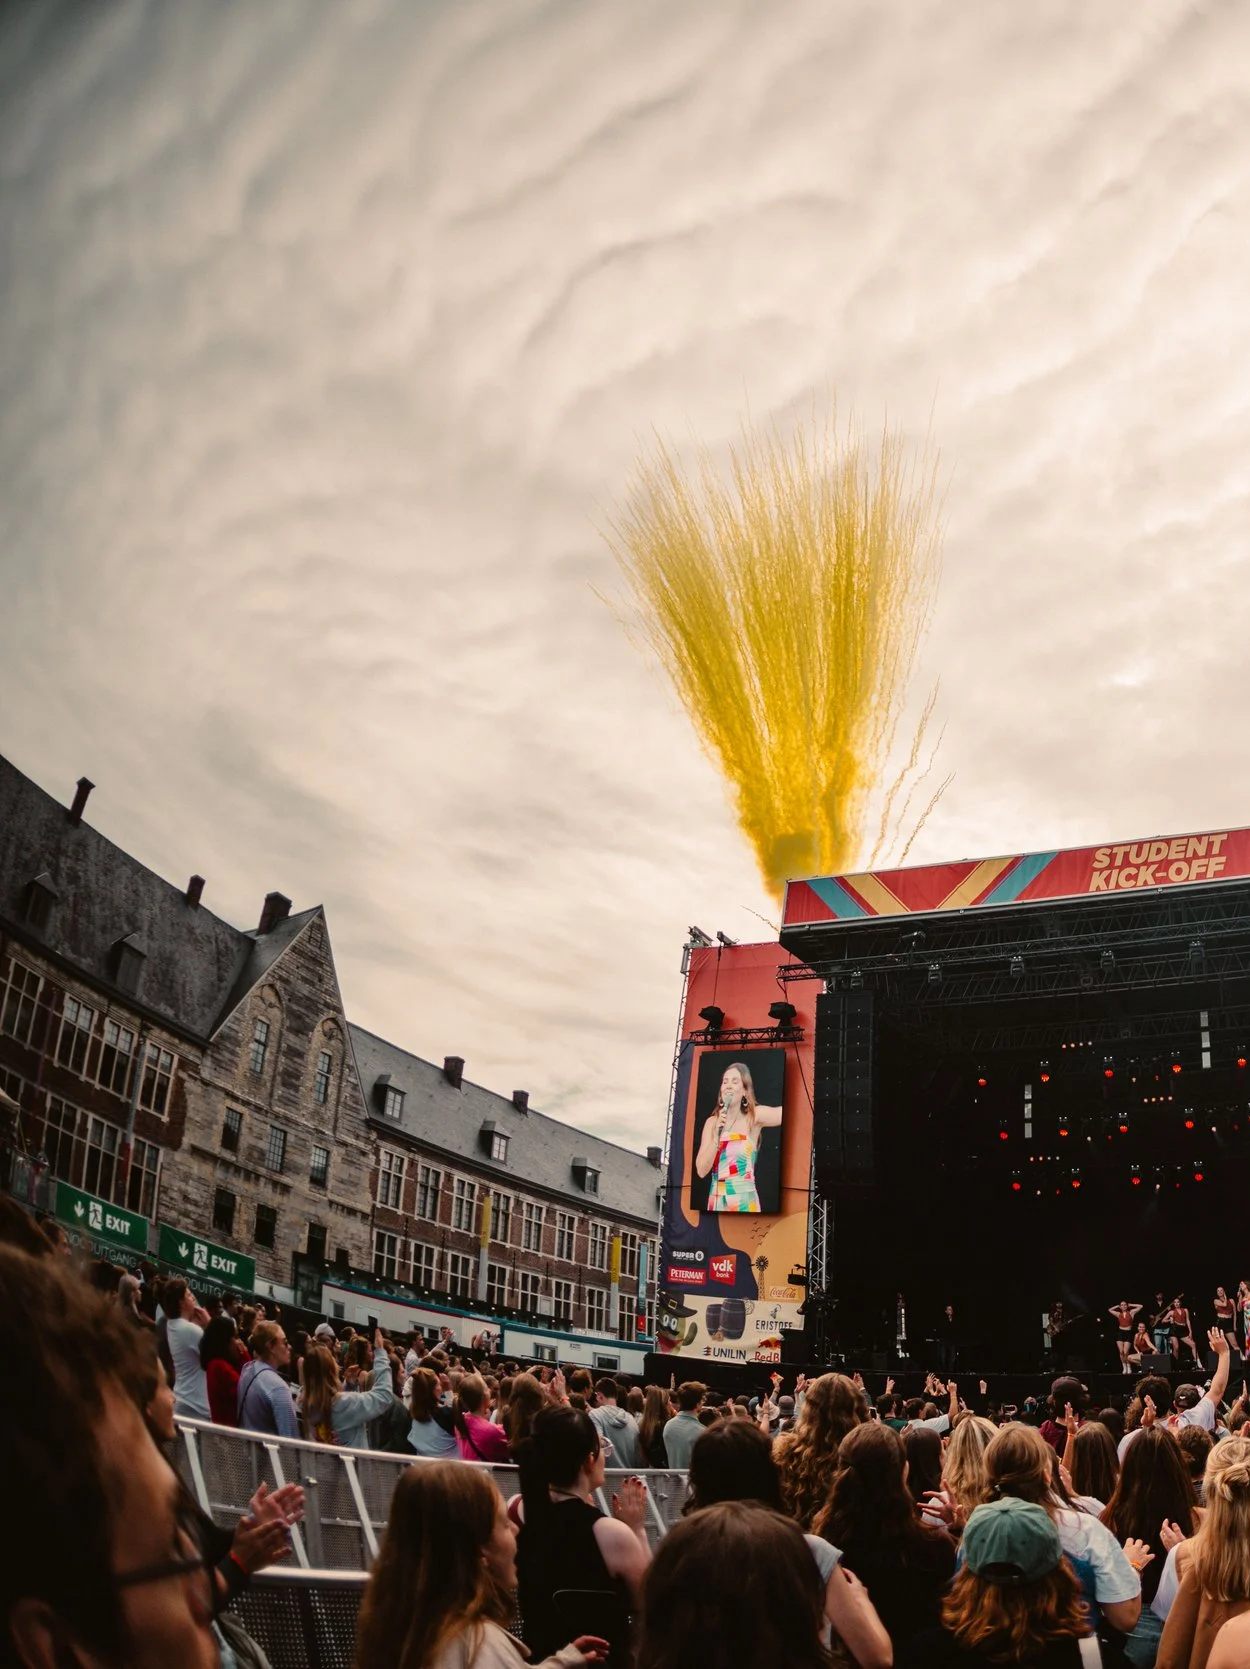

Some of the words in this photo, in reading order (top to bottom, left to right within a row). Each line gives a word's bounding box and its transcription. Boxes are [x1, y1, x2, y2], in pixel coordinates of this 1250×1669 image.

[1092, 834, 1228, 870] STUDENT
[1089, 856, 1227, 892] KICK-OFF
[106, 1214, 131, 1236] EXIT
[672, 1250, 695, 1259] SUPER
[211, 1254, 237, 1275] EXIT
[712, 1259, 734, 1273] vdk
[670, 1268, 704, 1280] PETERMAN
[755, 1319, 793, 1331] ERISTOFF
[713, 1347, 747, 1360] UNILIN
